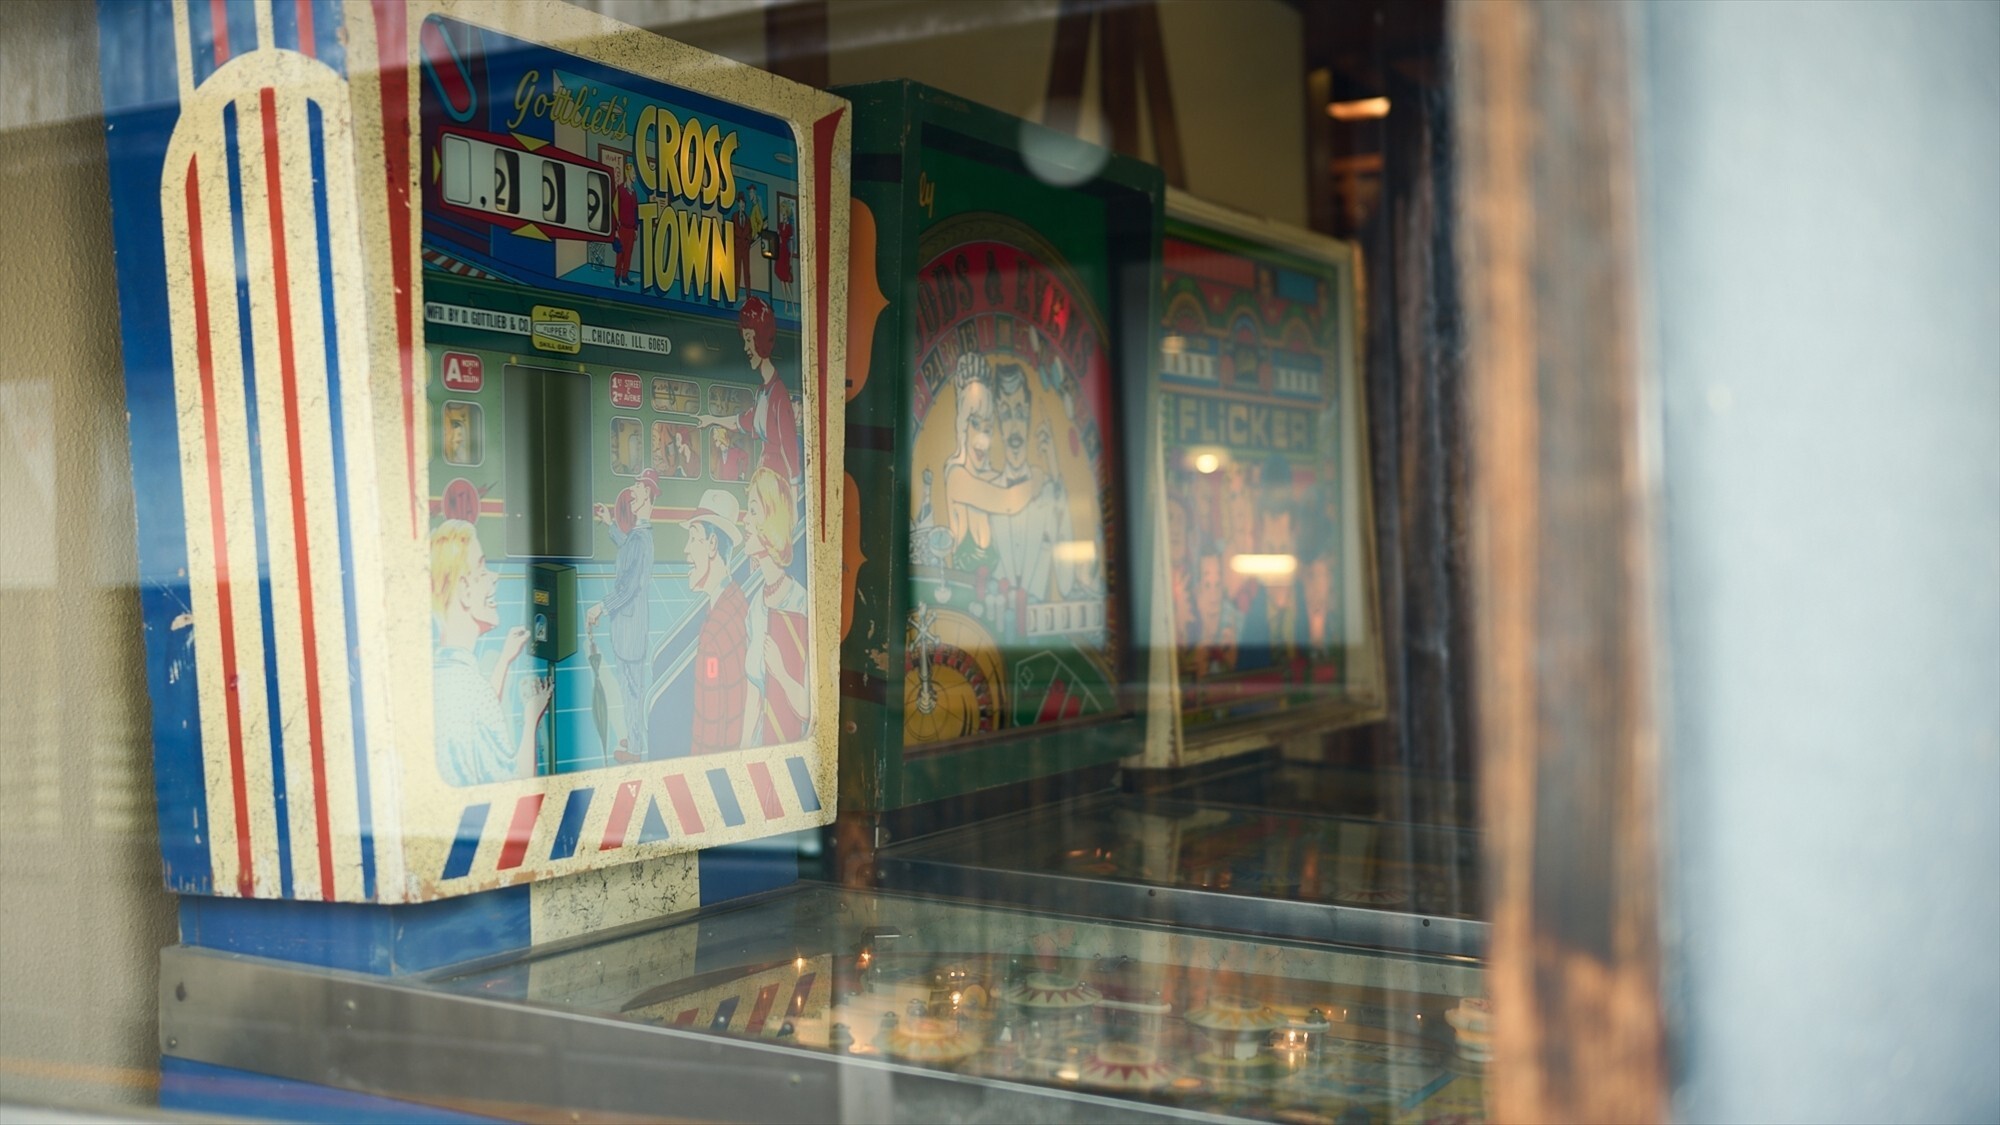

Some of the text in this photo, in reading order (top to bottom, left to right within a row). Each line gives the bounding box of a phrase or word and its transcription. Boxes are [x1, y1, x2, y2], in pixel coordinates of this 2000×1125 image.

[506, 69, 628, 141] Gottlieb's
[635, 104, 740, 210] CROSS
[637, 202, 736, 303] TOWN
[448, 307, 460, 323] BY
[471, 311, 507, 330] GOTTLIEB
[557, 343, 574, 352] GAME
[631, 335, 646, 350] ILL.
[648, 336, 669, 353] 60651
[446, 358, 462, 382] A
[1179, 397, 1308, 450] FLICKER
